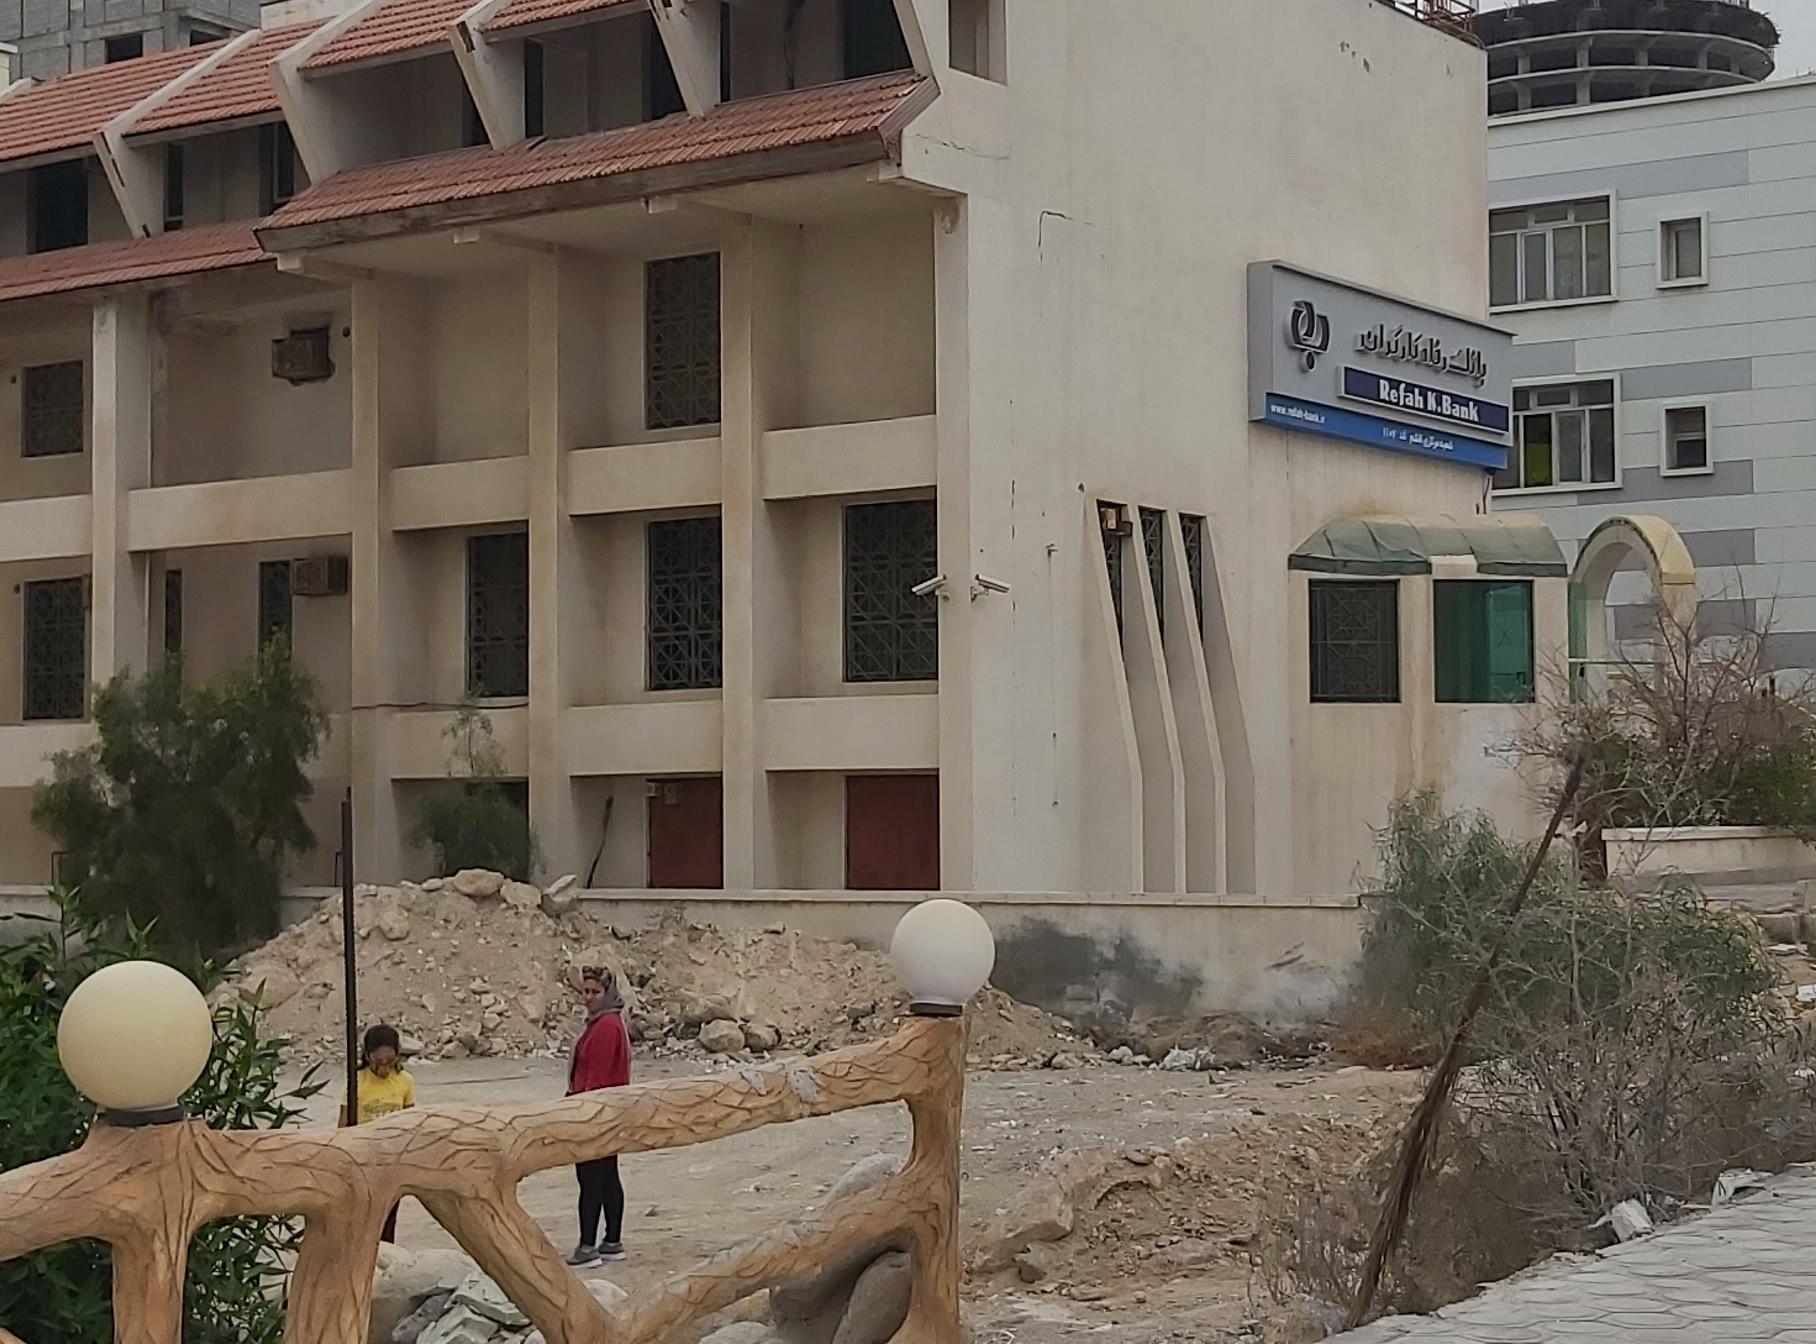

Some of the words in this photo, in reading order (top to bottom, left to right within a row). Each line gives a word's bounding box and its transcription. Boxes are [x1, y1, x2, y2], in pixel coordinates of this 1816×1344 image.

[1354, 322, 1424, 360] کارگران
[1418, 336, 1448, 373] رفاه
[1449, 347, 1487, 389] بانک
[1379, 378, 1424, 410] Refah
[1427, 391, 1480, 422] K.Bank
